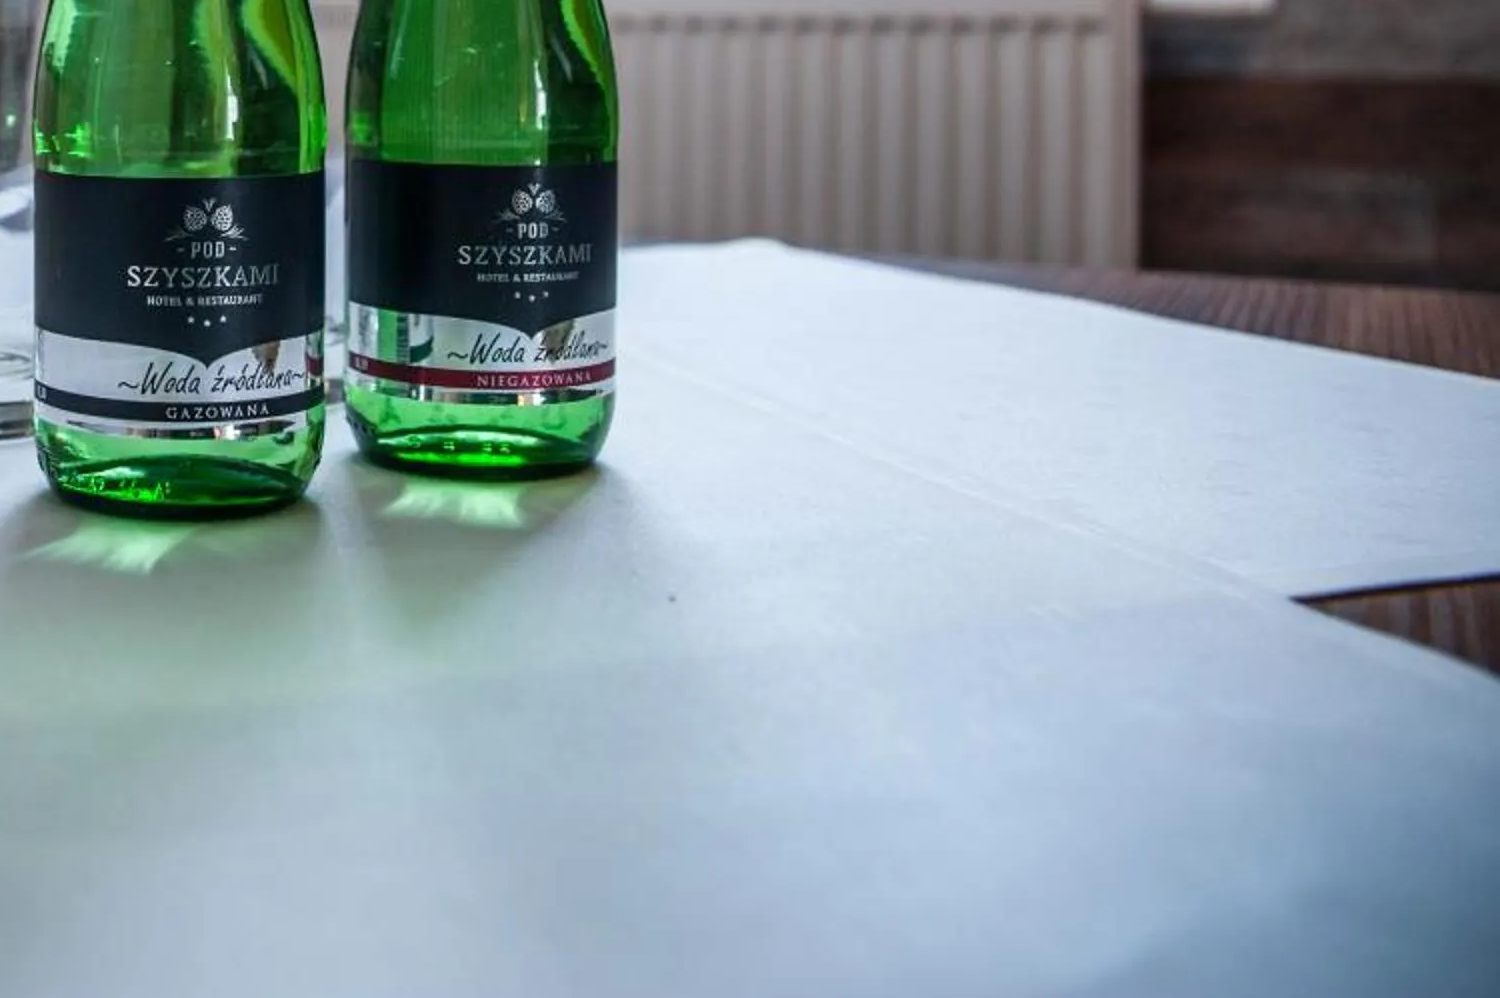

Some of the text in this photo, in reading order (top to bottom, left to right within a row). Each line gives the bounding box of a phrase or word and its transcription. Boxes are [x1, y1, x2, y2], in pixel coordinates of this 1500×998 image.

[517, 222, 550, 239] POD
[190, 241, 226, 259] POD
[457, 243, 593, 266] SZYSZKAMI
[126, 263, 279, 288] SZYSZKAMI
[477, 272, 509, 283] HOTEL
[147, 295, 182, 307] HOTEL
[470, 332, 526, 364] Woda
[140, 362, 201, 395] Woda
[476, 370, 592, 388] NIEGAZOWANA
[165, 403, 270, 420] GAZOWANA
